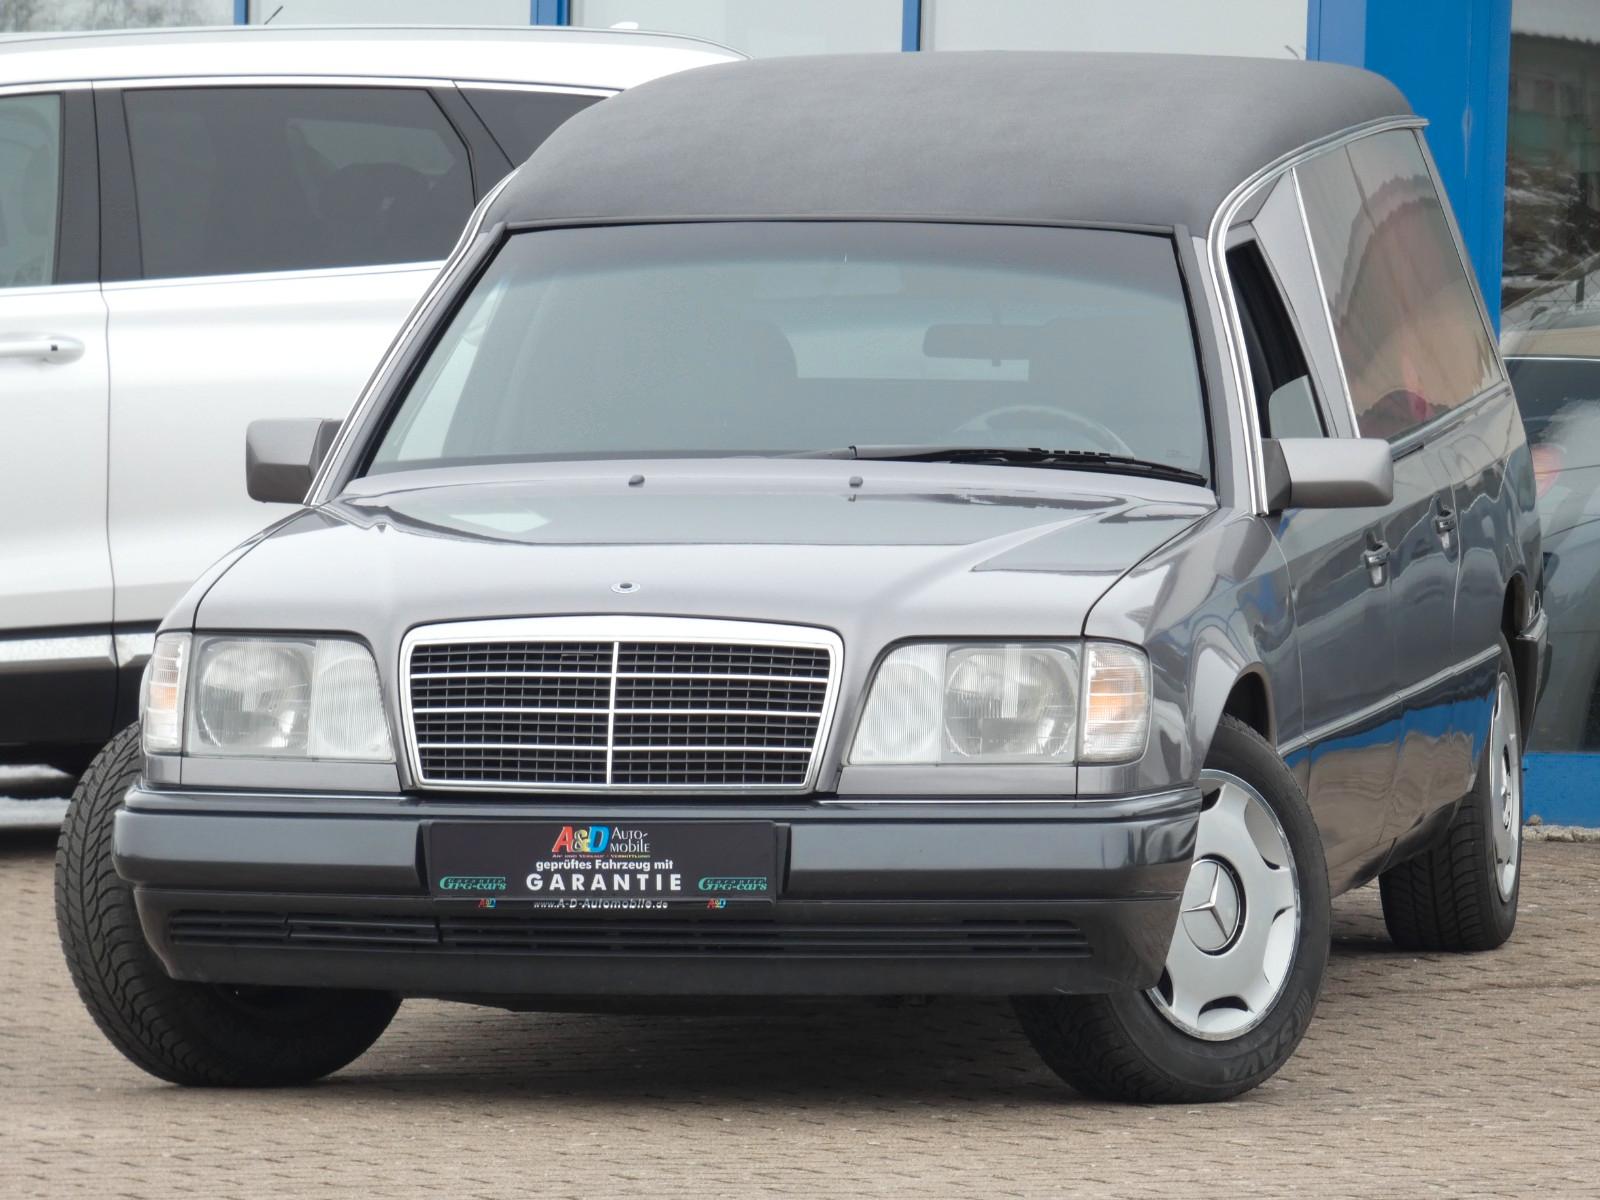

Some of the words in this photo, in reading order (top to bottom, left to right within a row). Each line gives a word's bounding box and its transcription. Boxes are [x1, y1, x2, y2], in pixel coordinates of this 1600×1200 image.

[551, 825, 610, 853] A&D
[535, 859, 592, 872] geprüftes
[595, 859, 651, 871] Fahrzeug
[654, 859, 674, 870] mit
[526, 873, 682, 891] GARANTIE
